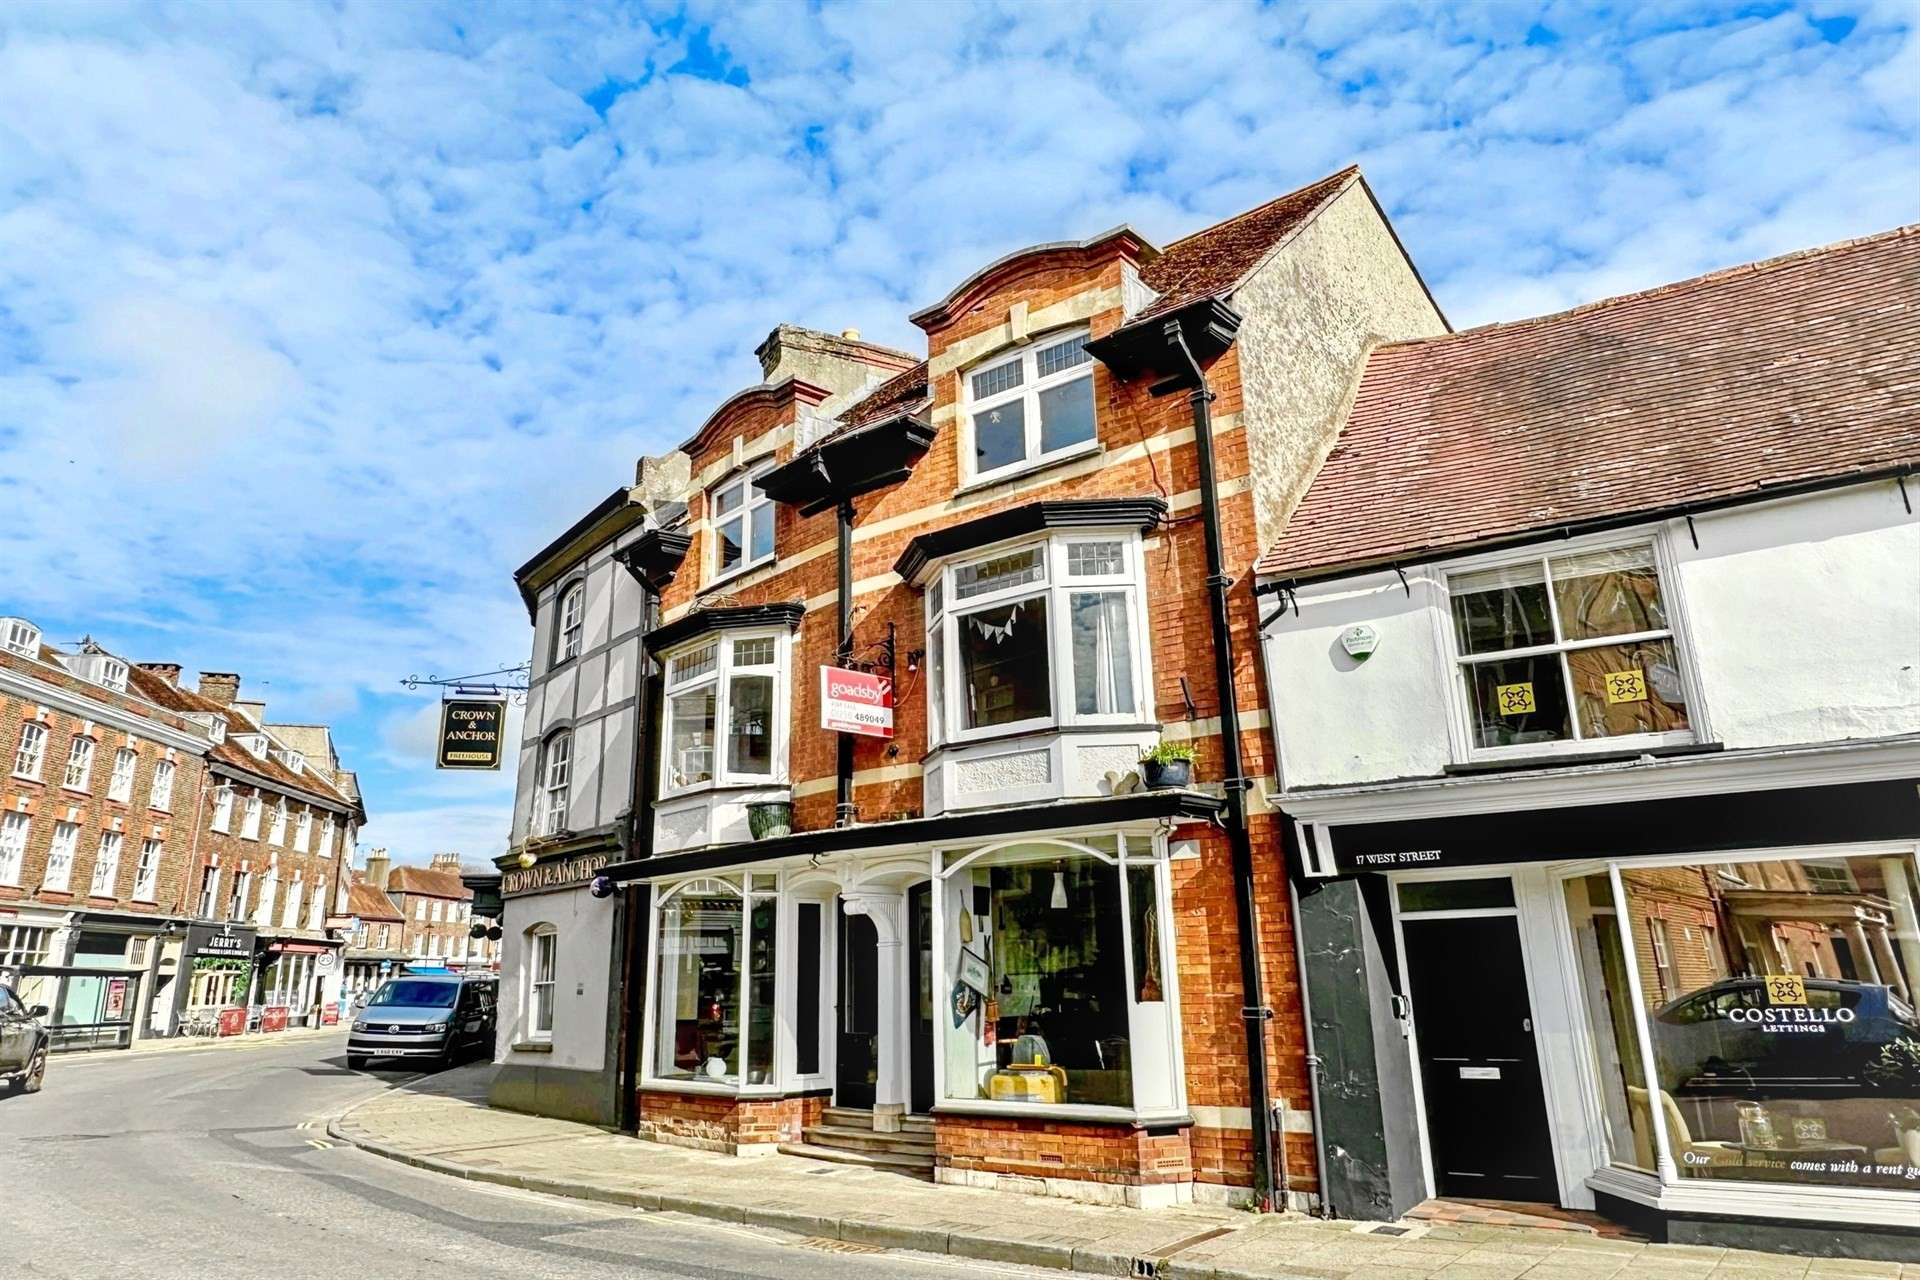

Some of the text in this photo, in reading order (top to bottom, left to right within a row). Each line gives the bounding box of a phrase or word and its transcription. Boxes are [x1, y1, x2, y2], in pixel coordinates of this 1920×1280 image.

[831, 682, 880, 704] goadsby
[451, 710, 496, 720] CROWN
[854, 712, 885, 725] 489049
[468, 720, 477, 729] &
[446, 731, 496, 741] ANCHOR
[1356, 850, 1442, 865] 17 WEST STREET
[502, 855, 607, 893] CROWN & ANCHOR
[209, 936, 243, 949] JERRY'S
[1729, 1007, 1856, 1023] COSTELLO
[1762, 1024, 1826, 1033] LETTINGS
[1683, 1152, 1711, 1165] Our
[1790, 1159, 1827, 1172] comes
[1830, 1160, 1859, 1174] with
[1862, 1165, 1873, 1174] a
[1876, 1163, 1904, 1175] rent
